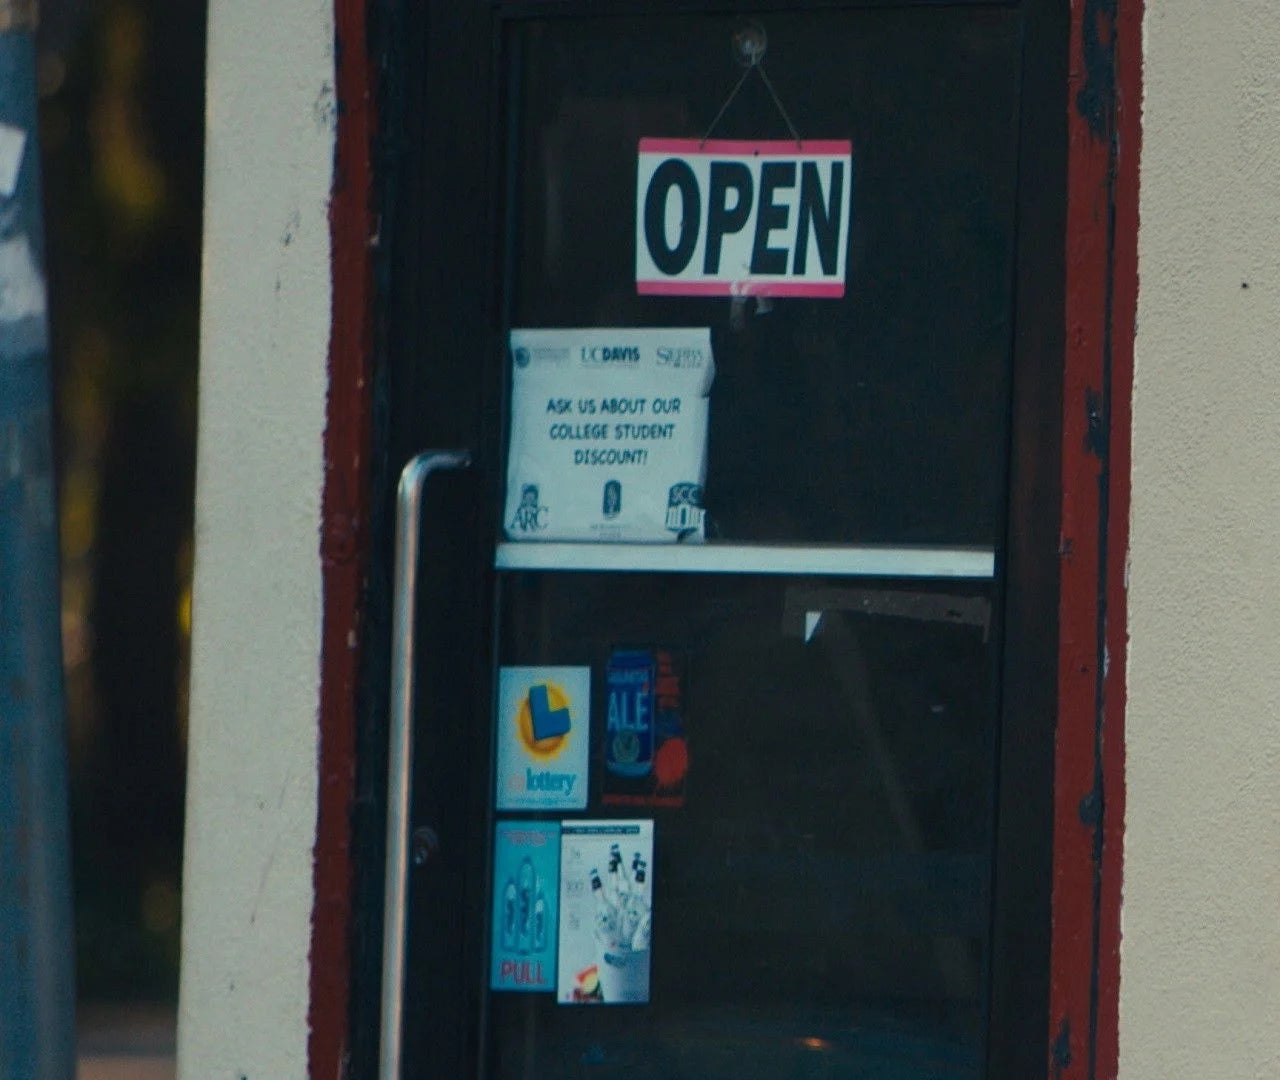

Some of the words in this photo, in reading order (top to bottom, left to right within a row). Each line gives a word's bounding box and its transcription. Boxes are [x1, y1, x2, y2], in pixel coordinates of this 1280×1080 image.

[643, 157, 845, 276] OPEN
[546, 398, 572, 414] ASK
[578, 398, 597, 414] US
[600, 398, 647, 414] ABOUT
[652, 398, 682, 414] OUR
[549, 423, 610, 440] COLLEGE
[614, 423, 676, 440] STUDENT
[573, 449, 649, 466] DISCOUNT!
[510, 505, 549, 531] ARC
[607, 691, 649, 731] ALE
[526, 766, 577, 796] lottery
[500, 959, 546, 985] PULL
